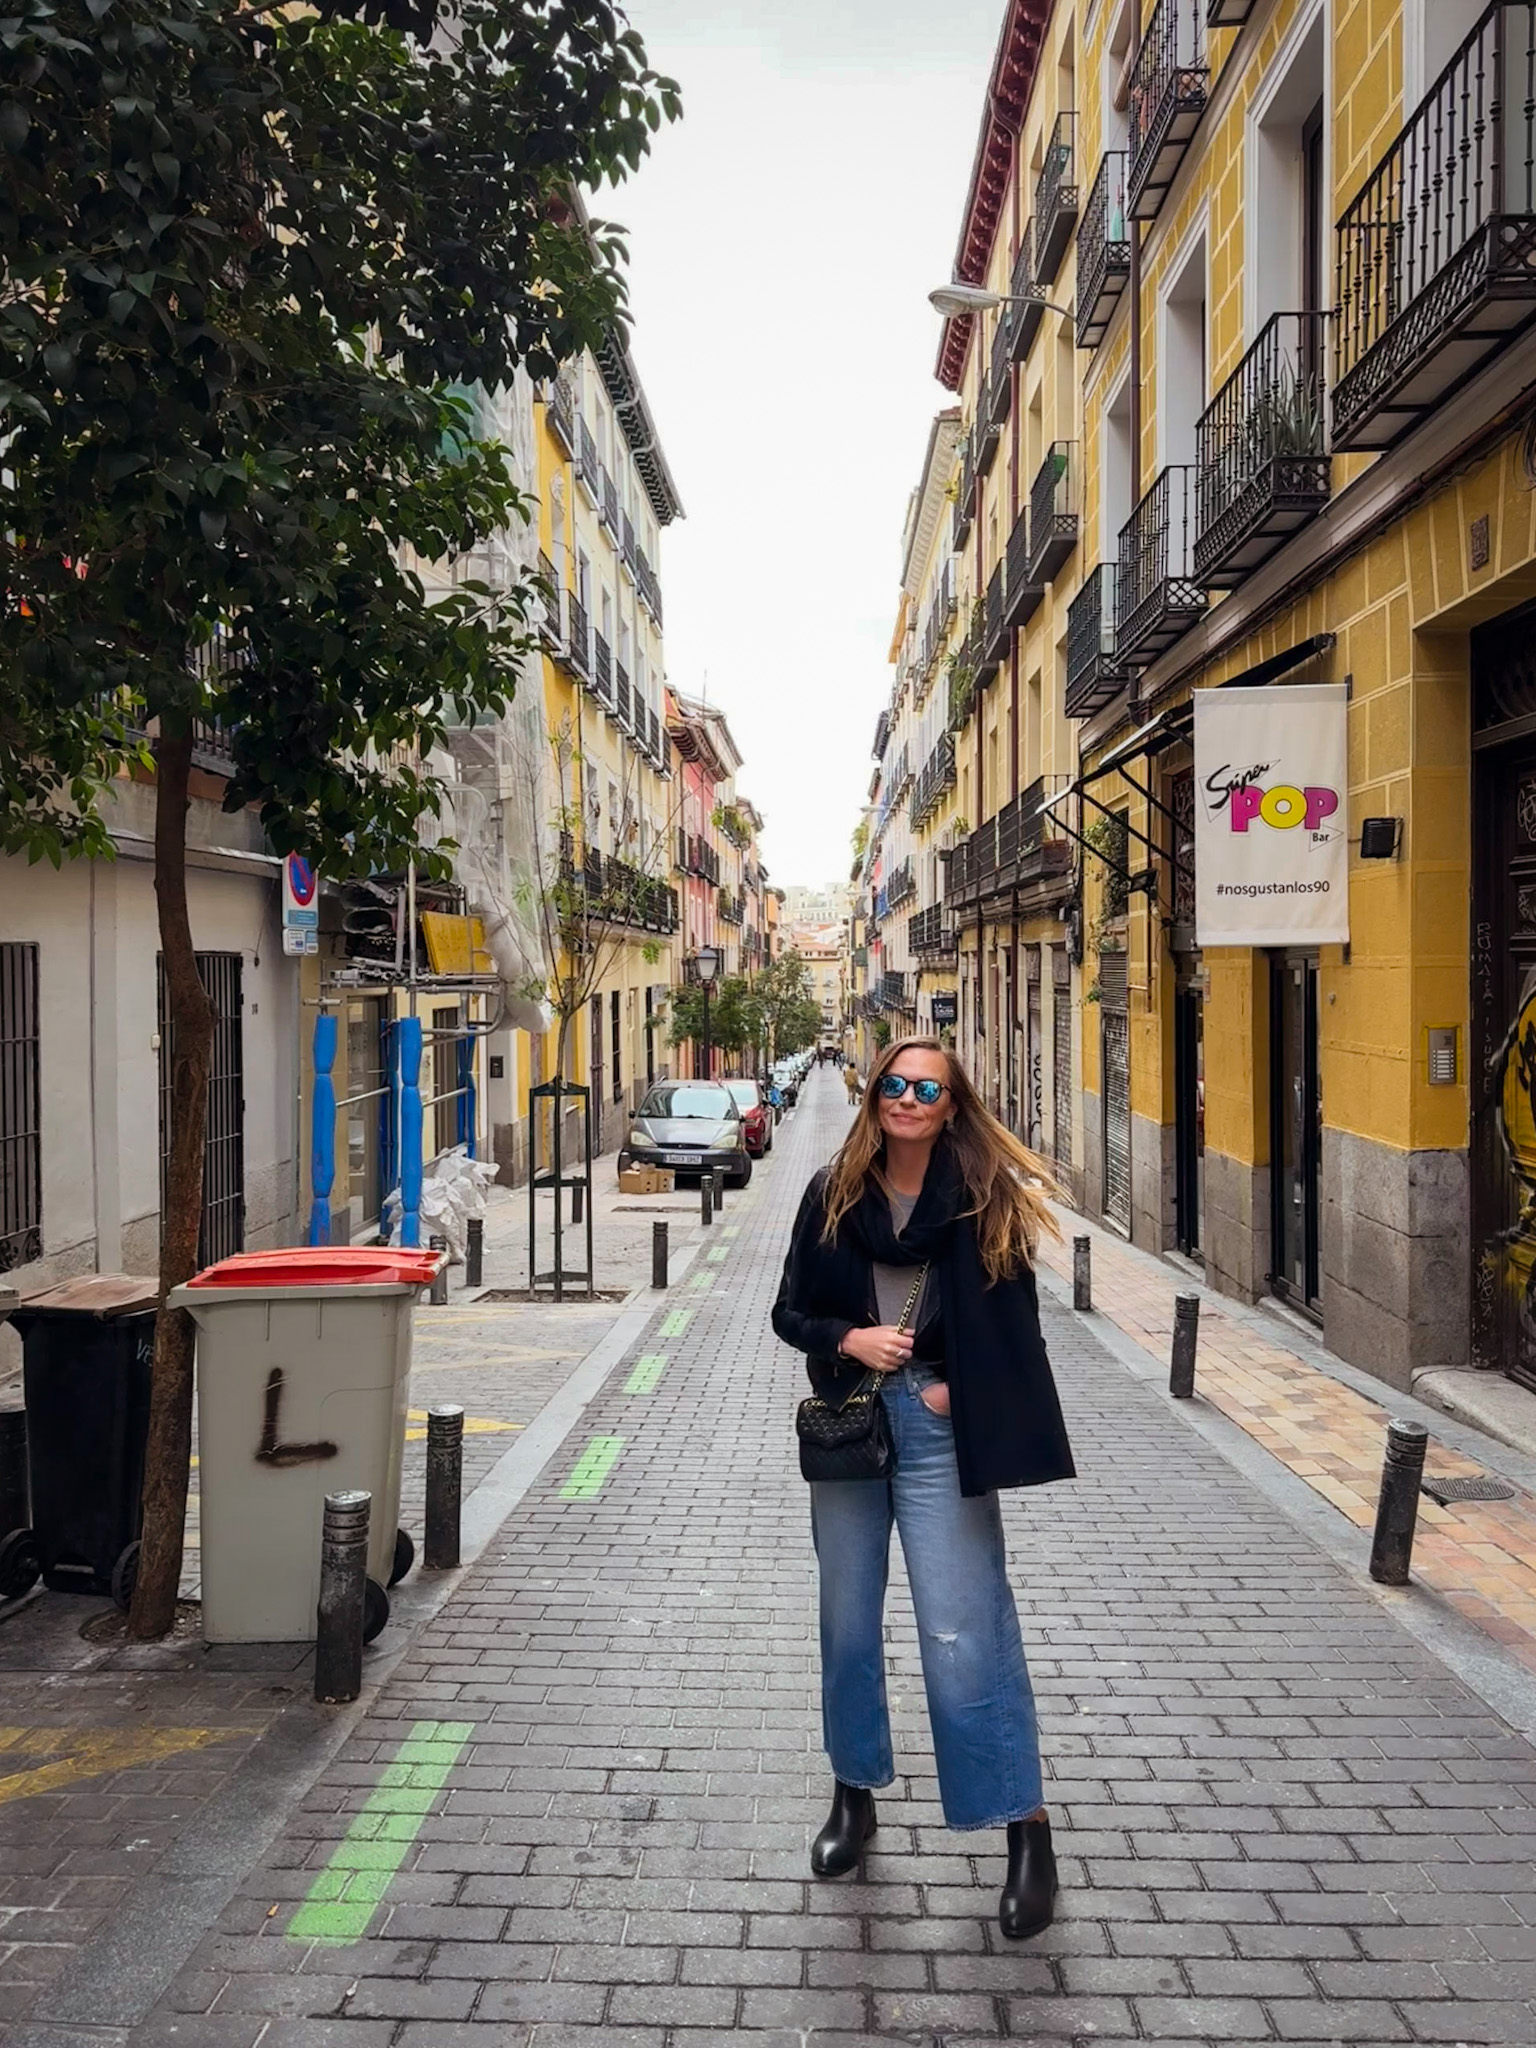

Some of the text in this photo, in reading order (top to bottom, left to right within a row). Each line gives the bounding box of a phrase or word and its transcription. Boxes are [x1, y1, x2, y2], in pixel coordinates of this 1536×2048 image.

[1231, 785, 1339, 832] POP
[1312, 832, 1330, 842] Bar
[1216, 880, 1330, 898] #nosgustanlos90
